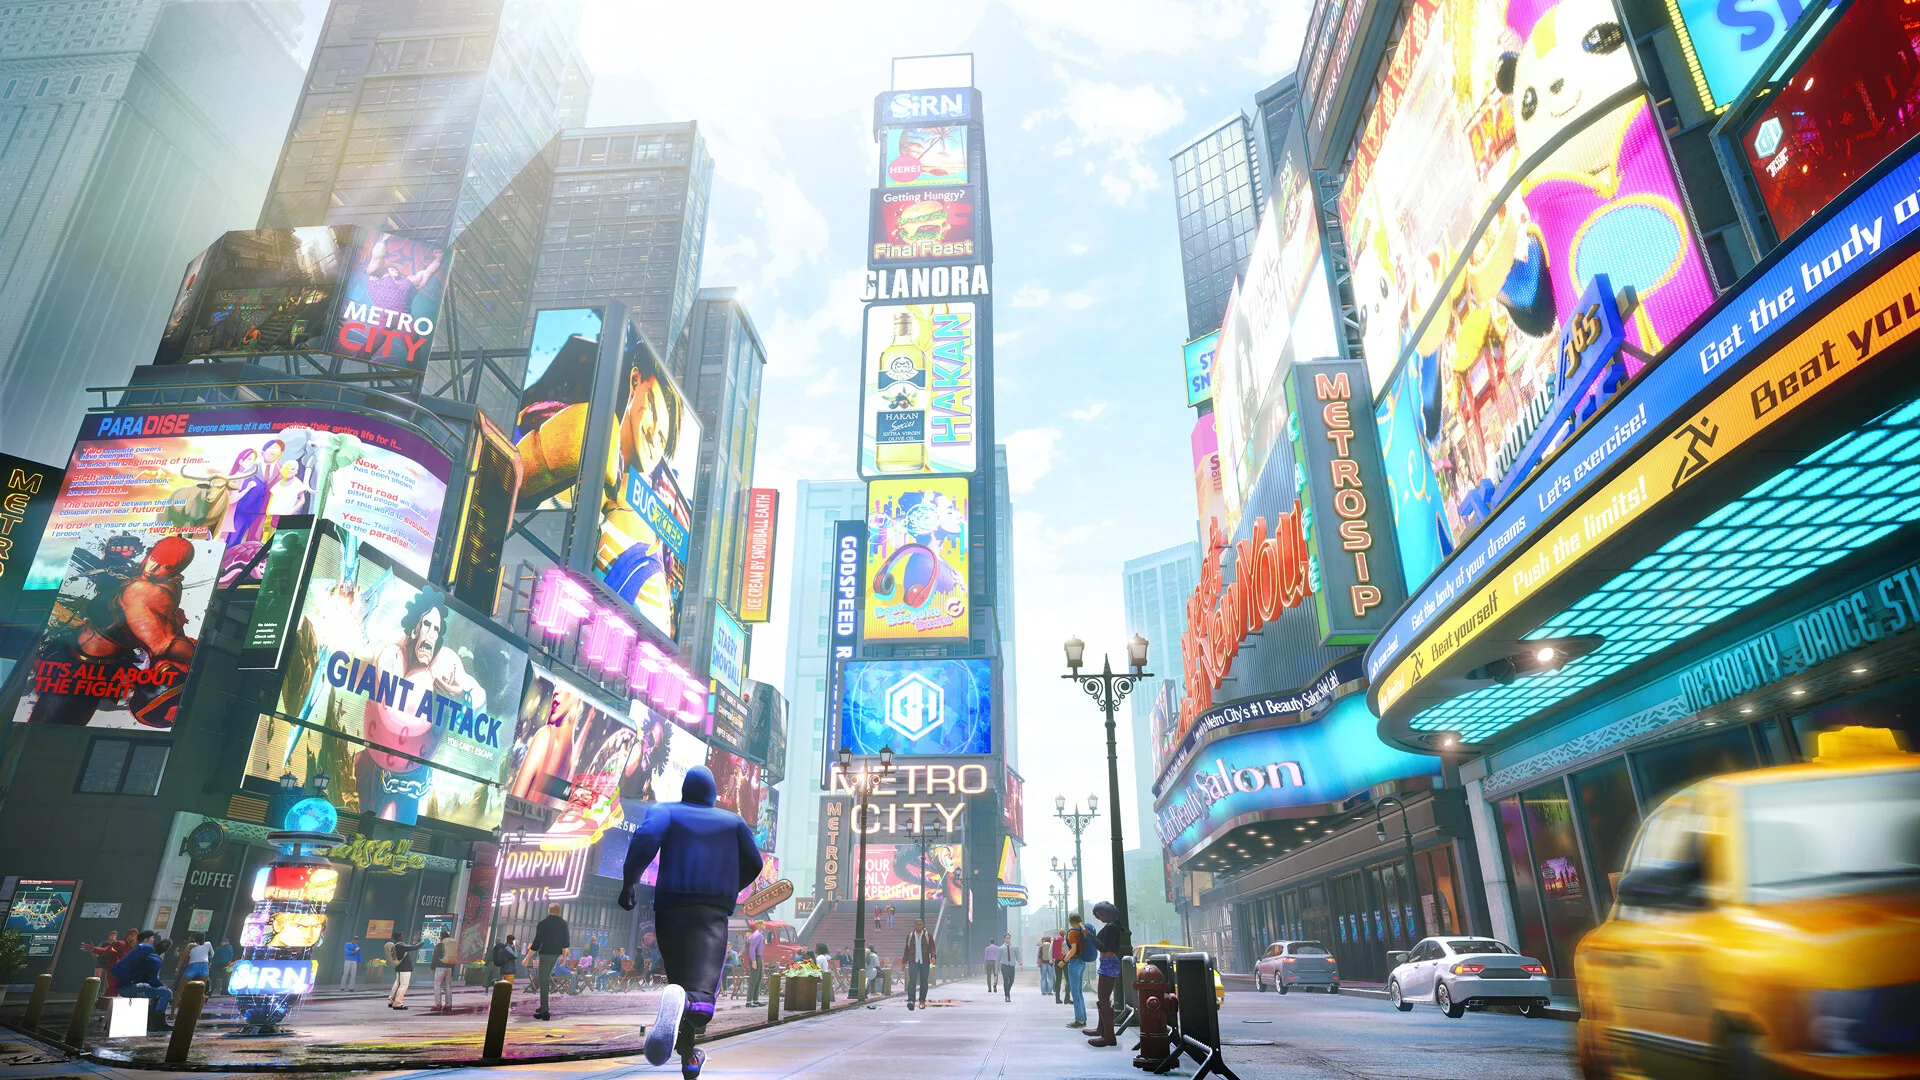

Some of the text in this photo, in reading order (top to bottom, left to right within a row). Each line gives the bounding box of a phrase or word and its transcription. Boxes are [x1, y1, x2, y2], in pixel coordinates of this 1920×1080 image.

[889, 165, 921, 174] HERE!
[883, 190, 966, 204] Getting Hungry?
[874, 240, 974, 259] Final Feast
[1699, 322, 1746, 375] Get
[1748, 286, 1796, 335] the
[1800, 215, 1883, 293] body
[343, 300, 434, 336] METRO
[339, 322, 428, 362] CITY
[931, 312, 972, 447] HAKAN
[1750, 339, 1841, 420] Beat
[97, 413, 190, 437] PARADISE
[188, 423, 218, 433] Everyone
[218, 423, 243, 432] dreams
[243, 422, 252, 430] of
[252, 421, 258, 430] it
[258, 421, 272, 430] and
[310, 421, 332, 432] their
[332, 424, 359, 437] entire
[360, 429, 375, 441] life
[375, 433, 389, 445] for
[885, 412, 919, 420] HAKAN
[83, 447, 104, 455] Two
[135, 446, 162, 454] powers
[87, 461, 107, 469] since
[107, 460, 121, 468] the
[121, 458, 168, 469] beginning
[169, 457, 181, 465] of
[1537, 403, 1648, 513] Let's exercise!
[69, 480, 110, 488] production
[72, 473, 97, 482] Birth
[353, 465, 390, 481] has been
[388, 469, 400, 478] the
[401, 474, 416, 485] road
[62, 501, 81, 509] The
[83, 500, 120, 508] balance
[347, 489, 399, 509] pitiful people
[350, 480, 373, 494] This
[375, 488, 399, 502] road
[1314, 371, 1382, 618] METROSIP
[0, 468, 44, 577] METR
[59, 508, 90, 516] collapse
[130, 505, 165, 514] future!
[356, 500, 373, 510] this
[373, 506, 395, 518] world
[396, 513, 403, 521] to
[55, 522, 64, 530] In
[66, 521, 92, 530] order
[103, 521, 127, 529] insure
[342, 522, 409, 550] to the paradise!
[373, 520, 390, 533] This
[1512, 474, 1649, 596] Push the limits!
[746, 494, 771, 611] ICE CREAM BY SNOWBALL EARTH
[836, 535, 858, 637] GODSPEED
[1411, 515, 1528, 632] Get the body of your dreams
[1430, 589, 1501, 662] Beat yourself
[717, 626, 738, 660] STARRY
[1679, 632, 1781, 714] METROCITY
[1792, 590, 1879, 667] DANCE
[37, 660, 179, 687] IT'S ALL ABOUT
[711, 644, 741, 688] SNOWBALL
[34, 675, 135, 700] THE FIGHT
[327, 650, 503, 749] GIANT ATTACK
[1223, 704, 1251, 723] City's
[1250, 702, 1265, 717] #1
[1266, 696, 1304, 714] Beauty
[1302, 689, 1322, 709] Salon
[830, 763, 988, 796] METRO
[1193, 757, 1304, 806] Salon
[850, 802, 966, 834] CITY
[190, 870, 235, 889] COFFEE
[504, 850, 573, 880] DRIPPIN'
[421, 894, 446, 908] COFFEE
[510, 886, 550, 903] STYLE
